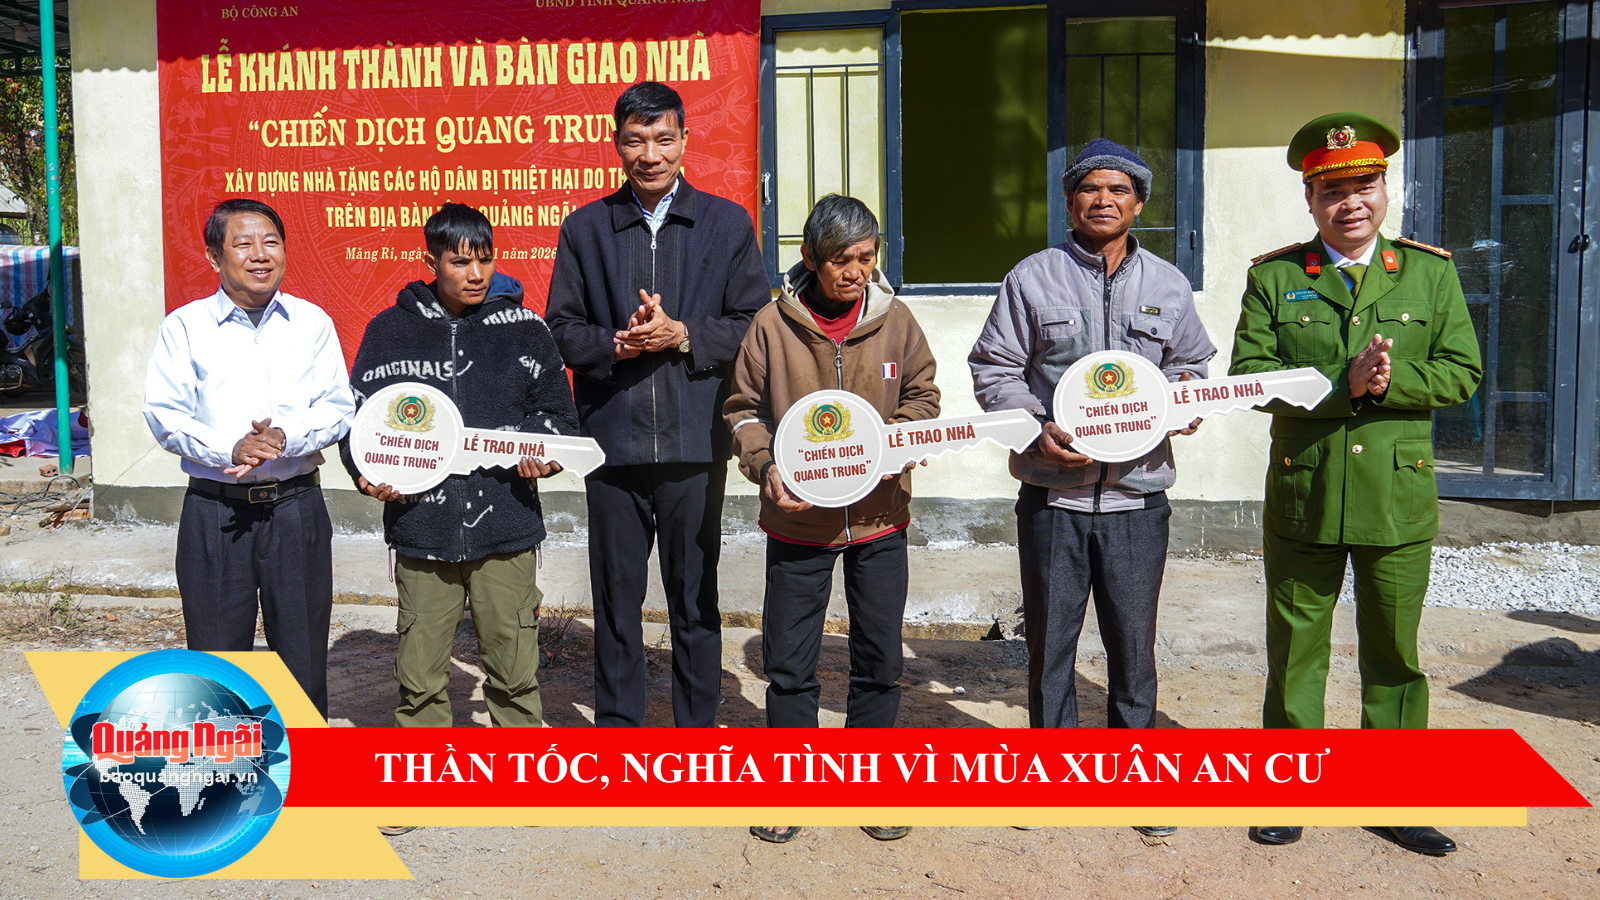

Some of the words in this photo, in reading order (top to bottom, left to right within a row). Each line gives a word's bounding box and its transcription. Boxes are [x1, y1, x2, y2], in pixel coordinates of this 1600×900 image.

[221, 5, 239, 21] BỘ
[241, 4, 278, 19] CÔNG
[280, 5, 299, 18] AN
[201, 37, 233, 93] LỄ
[239, 43, 337, 92] KHÁNH
[343, 40, 443, 90] THÀNH
[448, 37, 489, 87] VÀ
[495, 36, 559, 86] BÀN
[566, 41, 638, 84] GIAO
[645, 30, 711, 82] NHÀ
[248, 105, 347, 148] “CHIẾN
[355, 116, 426, 152] DỊCH
[435, 114, 535, 154] QUANG
[543, 113, 617, 144] TRUN
[225, 167, 254, 193] XÂY
[257, 169, 299, 197] DỰNG
[303, 167, 336, 192] NHÀ
[338, 166, 380, 197] TẶNG
[384, 166, 416, 192] CÁC
[419, 165, 441, 196] HỘ
[444, 165, 478, 191] DÂN
[482, 169, 499, 195] BỊ
[502, 164, 548, 195] THIỆT
[552, 168, 580, 195] HẠI
[583, 167, 605, 190] DO
[326, 202, 367, 228] TRÊN
[369, 206, 397, 232] ĐỊA
[345, 247, 379, 262] Măng
[381, 247, 398, 262] Ri,
[501, 247, 528, 260] năm
[529, 246, 558, 260] 2026
[1173, 385, 1191, 405] LỄ
[1194, 386, 1229, 403] TRAO
[1233, 379, 1265, 398] NHÀ
[1079, 401, 1119, 419] “CHIẾN
[1122, 400, 1148, 415] DỊCH
[888, 427, 904, 449] LỄ
[907, 429, 943, 446] TRAO
[946, 421, 976, 441] NHÀ
[1075, 423, 1112, 438] QUANG
[1114, 416, 1157, 433] TRUNG”
[375, 431, 412, 448] “CHIẾN
[414, 436, 439, 453] DỊCH
[463, 433, 480, 453] LỄ
[482, 438, 516, 456] TRAO
[518, 440, 546, 458] NHÀ
[798, 444, 837, 462] “CHIẾN
[838, 444, 864, 460] DỊCH
[364, 452, 401, 466] QUANG
[402, 456, 444, 470] TRUNG”
[793, 468, 829, 483] QUANG
[830, 459, 872, 477] TRUNG”
